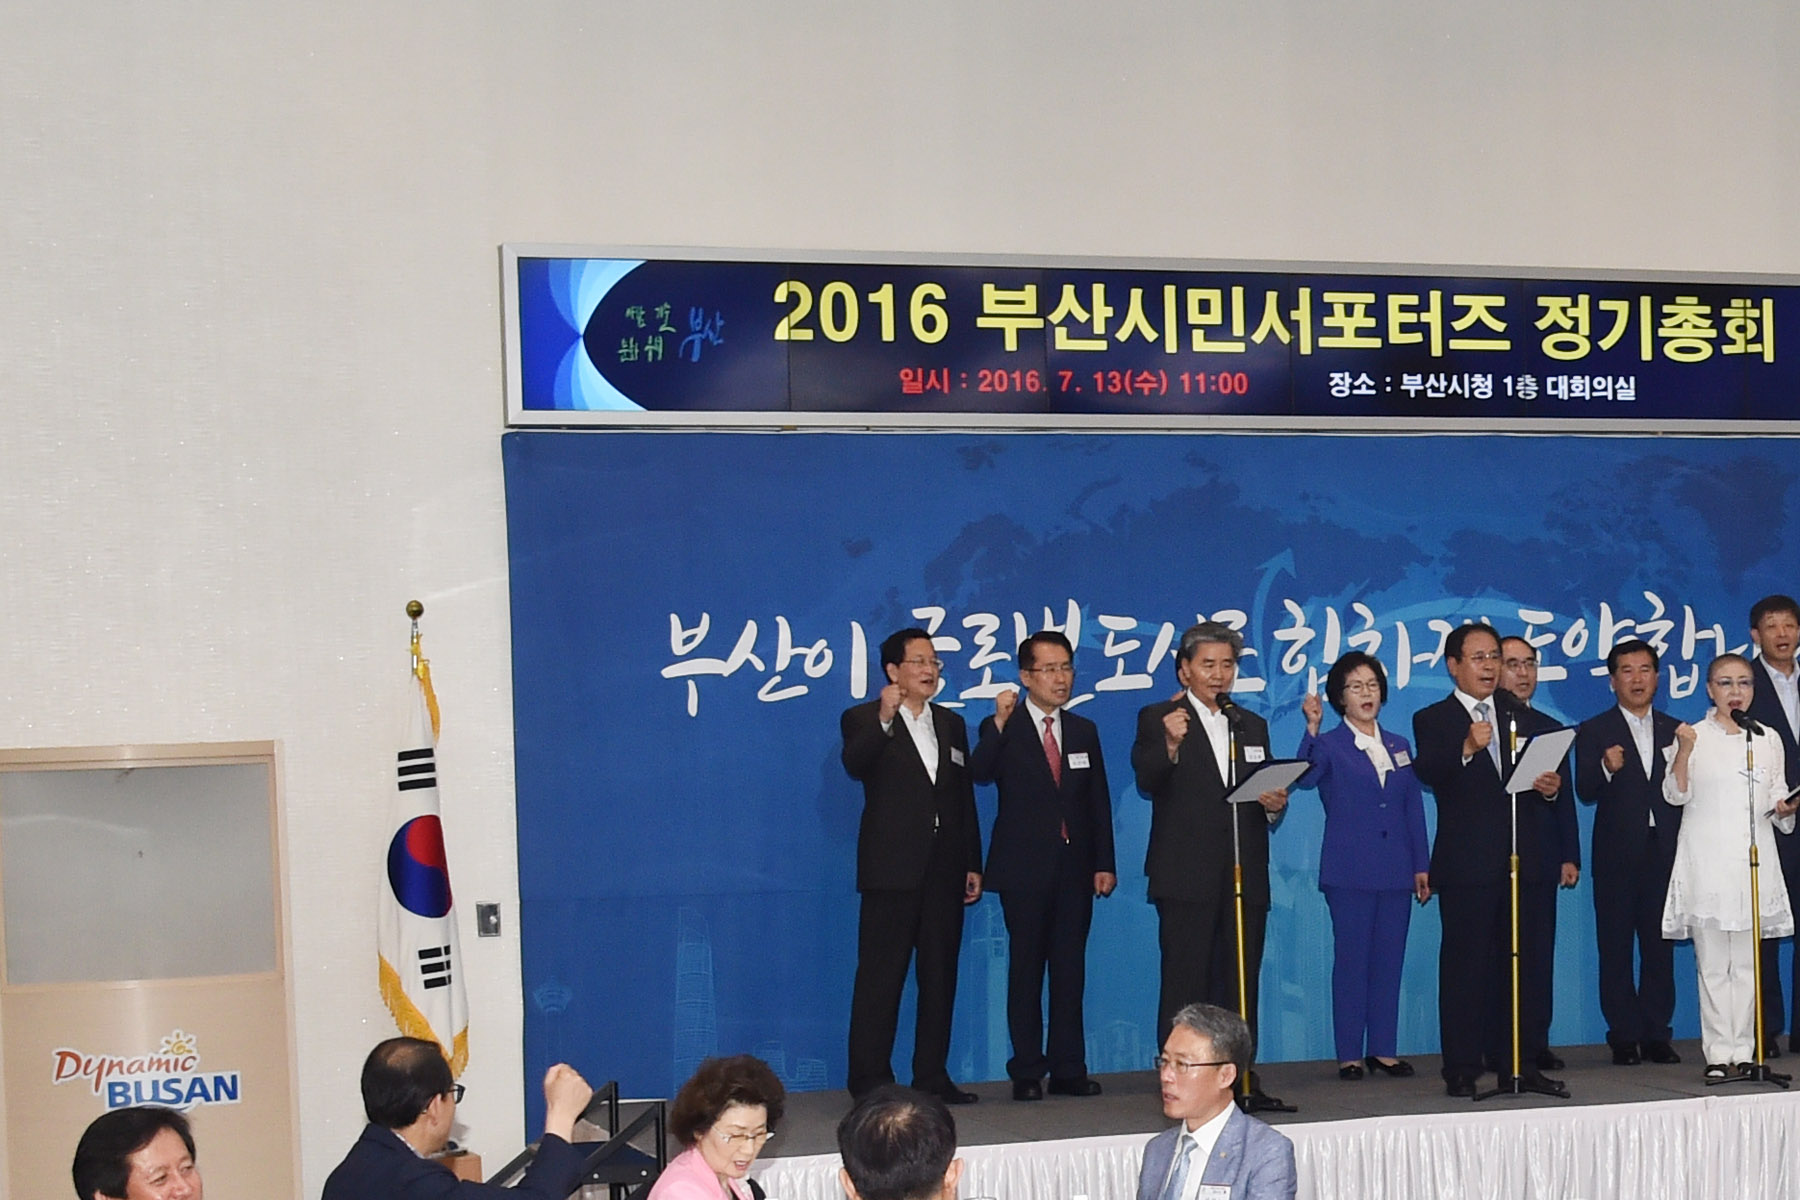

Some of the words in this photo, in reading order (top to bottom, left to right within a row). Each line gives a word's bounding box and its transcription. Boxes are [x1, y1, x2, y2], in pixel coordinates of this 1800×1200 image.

[774, 280, 949, 344] 2016
[976, 283, 1511, 357] 부산시민서포터즈
[1537, 294, 1774, 363] 정기총회
[899, 367, 950, 394] 일시
[978, 369, 1047, 393] 2016.
[1058, 370, 1081, 392] 7.
[1093, 369, 1169, 396] 13(수)
[1180, 371, 1249, 395] 11:00
[1328, 371, 1377, 398] 장소
[1400, 372, 1493, 399] 부산시청
[1502, 374, 1539, 400] 1층
[1546, 375, 1636, 401] 대회의실
[661, 612, 867, 717] 부산이
[55, 1050, 197, 1093] Dynamic
[107, 1074, 238, 1108] BUSAN
